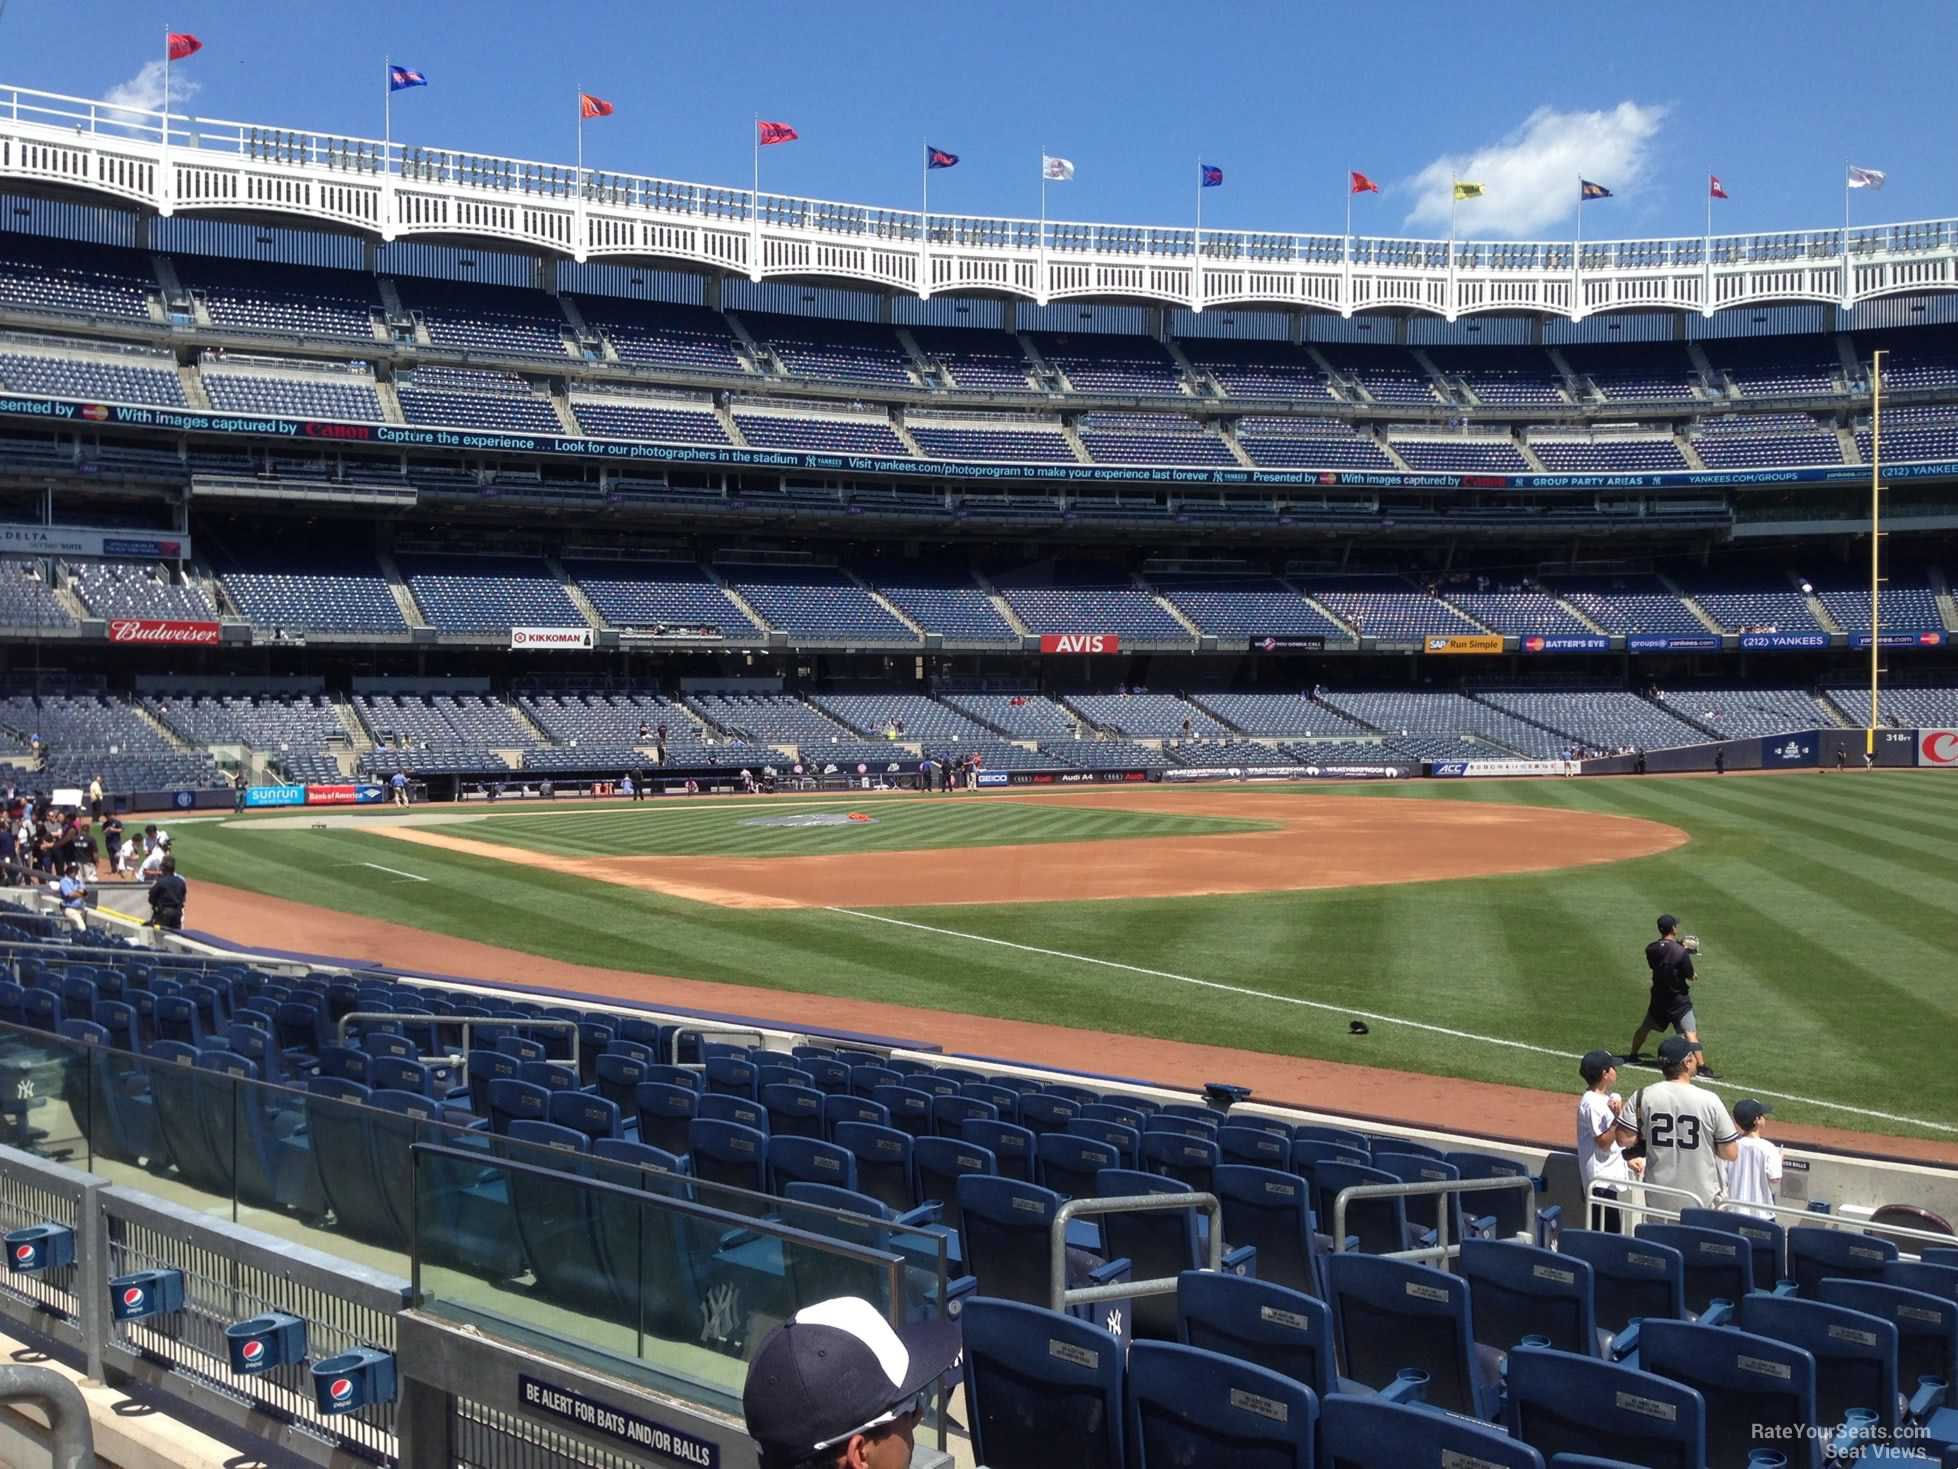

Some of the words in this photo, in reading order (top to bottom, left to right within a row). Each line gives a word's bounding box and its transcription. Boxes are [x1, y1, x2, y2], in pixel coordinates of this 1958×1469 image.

[55, 402, 74, 418] by
[117, 407, 152, 422] With
[156, 411, 208, 429] images
[212, 418, 275, 432] captured
[279, 421, 297, 436] by
[305, 422, 369, 439] Canon
[377, 427, 433, 443] Capture
[437, 430, 459, 445] the
[555, 439, 585, 452] Look
[588, 441, 605, 454] for
[608, 444, 628, 456] our
[630, 445, 716, 461] photographers
[719, 449, 729, 461] in
[732, 450, 751, 463] the
[753, 451, 798, 465] stadium
[848, 457, 872, 470] Visit
[874, 458, 1020, 478] yankees.com/photoprogram
[1023, 466, 1035, 477] to
[1037, 467, 1066, 477] make
[1069, 468, 1093, 479] your
[1095, 468, 1150, 480] experience
[1152, 469, 1170, 481] last
[1173, 469, 1208, 481] forever
[1882, 467, 1909, 477] (212)
[1253, 471, 1302, 483] Presented
[1305, 472, 1317, 485] by
[1341, 473, 1365, 484] With
[1366, 473, 1401, 486] images
[1403, 474, 1445, 486] captured
[1447, 475, 1460, 487] by
[1533, 478, 1568, 486] GROUP
[1571, 478, 1604, 486] PARTY
[1607, 477, 1643, 485] AREAS
[1689, 472, 1797, 484] YANKEES.COM/GROUPS
[5, 531, 48, 541] DELTA
[111, 621, 217, 641] Budweiser
[528, 634, 581, 642] KIKKOMAN
[1743, 637, 1769, 647] (212)
[1772, 637, 1823, 647] YANKEES
[1859, 636, 1913, 644] yanees.com
[1055, 635, 1104, 653] AVIS
[1429, 640, 1446, 649] SAP
[1450, 640, 1467, 649] Run
[1469, 640, 1499, 651] Simple
[1546, 640, 1586, 648] BATTER'S
[1588, 640, 1605, 648] EYE
[1631, 639, 1667, 648] groups@
[1669, 639, 1715, 648] yankees.com
[1326, 766, 1385, 774] WEATHERPROOF
[1438, 764, 1462, 773] ACC
[978, 774, 1008, 782] GEICO
[1033, 775, 1052, 783] Audi
[1062, 773, 1080, 781] Audi
[1081, 773, 1094, 781] A4
[1125, 772, 1144, 781] Audi
[252, 789, 298, 800] sunrun
[309, 792, 327, 801] Bank
[327, 791, 335, 800] of
[334, 790, 364, 800] America
[1650, 1112, 1701, 1151] 23
[126, 1306, 143, 1314] pepsi
[245, 1360, 263, 1369] pepsi
[333, 1399, 352, 1409] pepsi
[526, 1383, 540, 1401] BE
[541, 1390, 573, 1416] ALERT
[575, 1401, 595, 1425] FOR
[597, 1409, 625, 1436] BATS
[627, 1421, 671, 1450] AND/OR
[673, 1436, 710, 1467] BALLS
